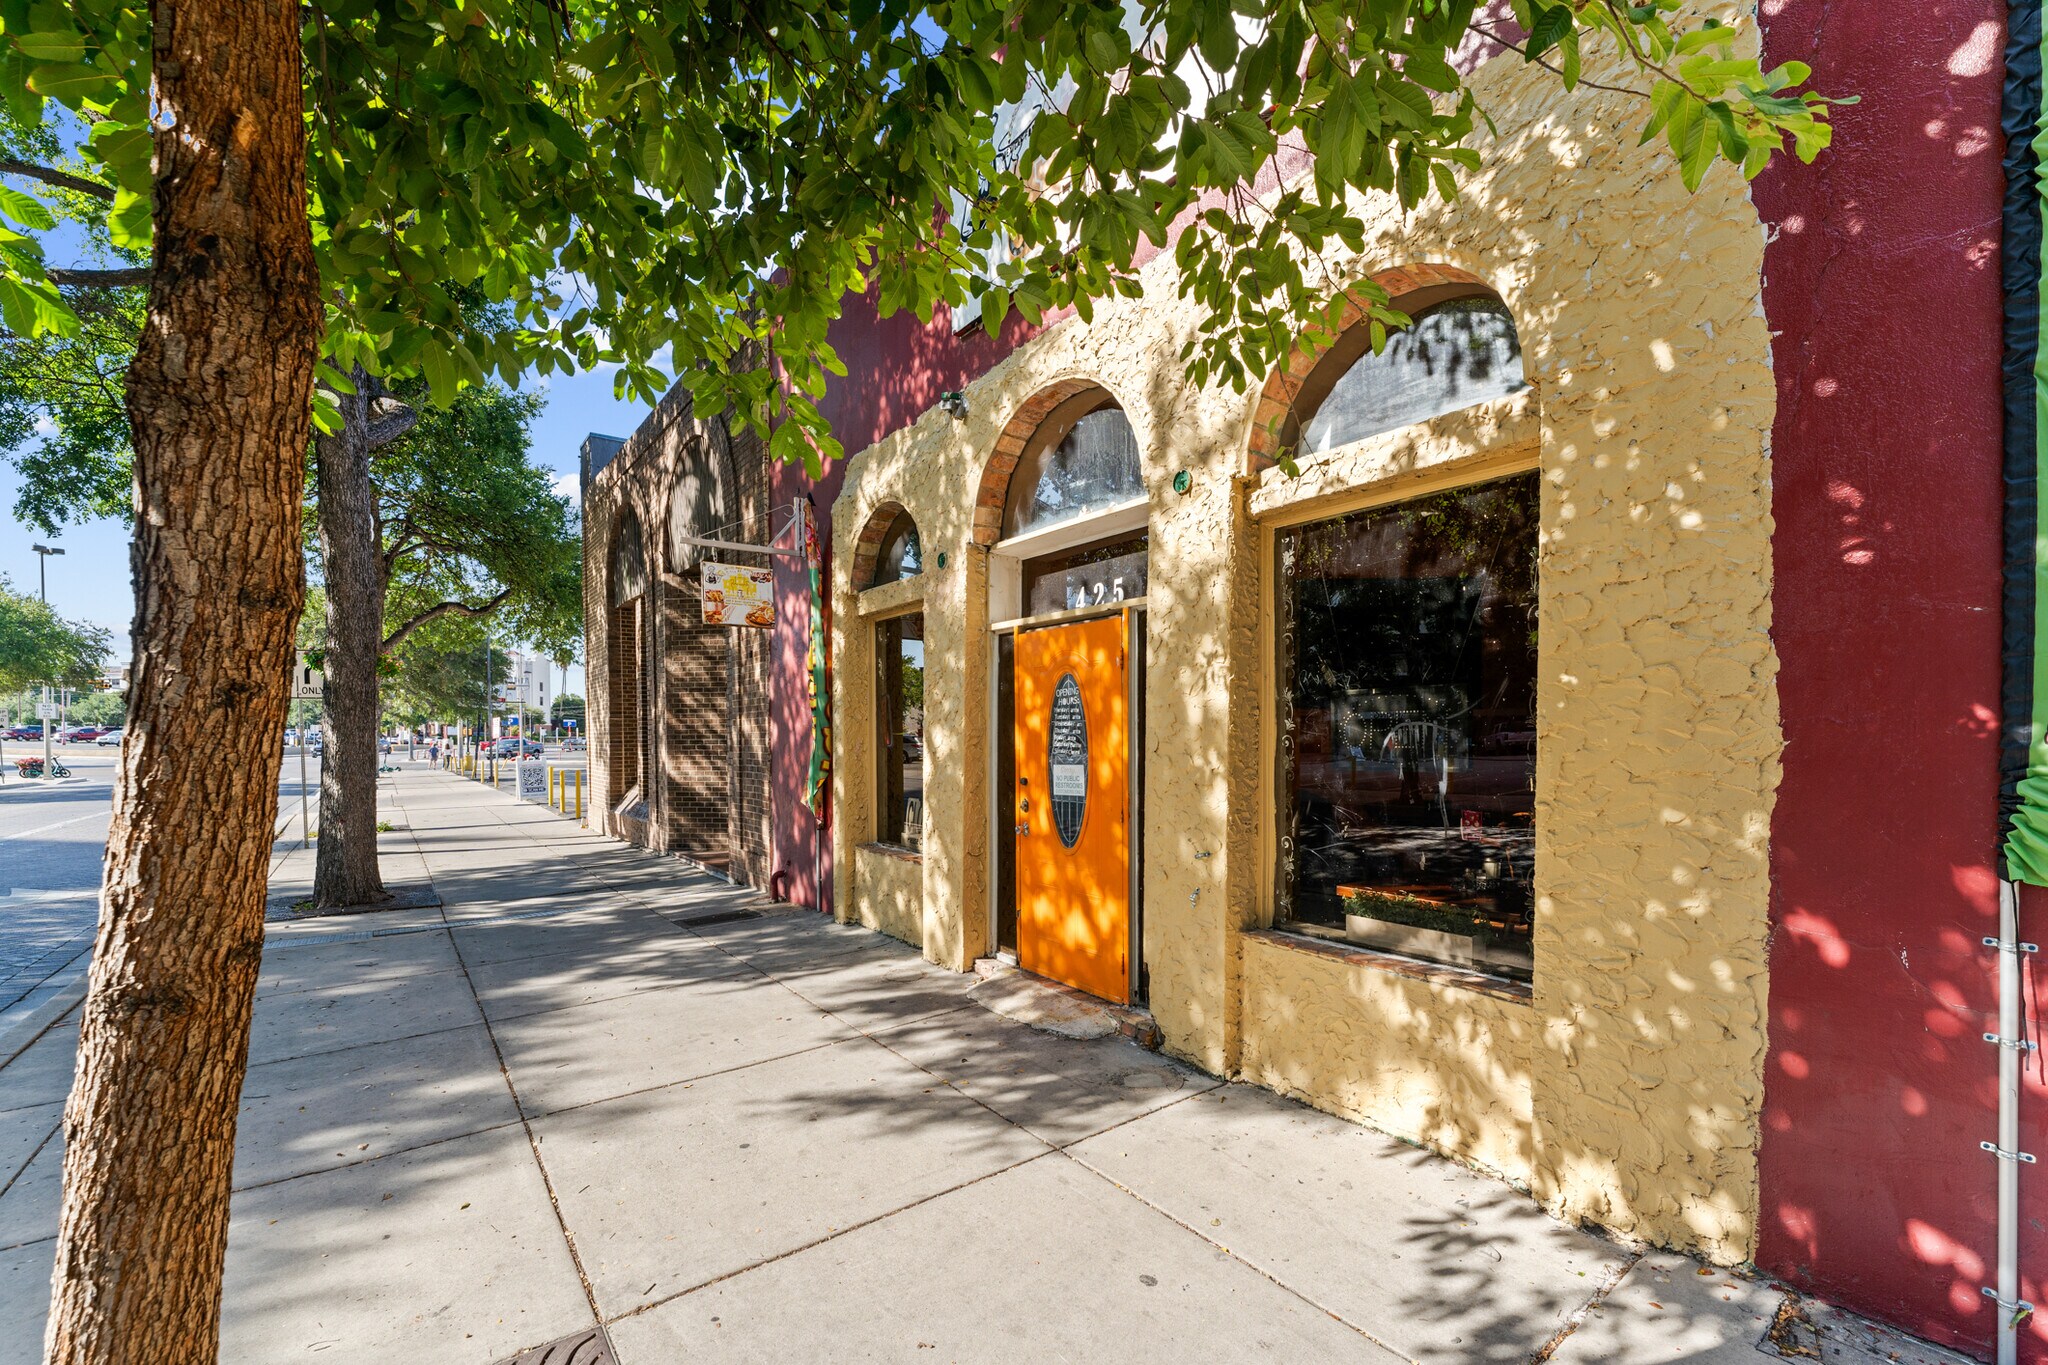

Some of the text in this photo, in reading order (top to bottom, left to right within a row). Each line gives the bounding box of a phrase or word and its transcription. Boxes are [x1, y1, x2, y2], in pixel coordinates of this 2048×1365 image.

[1075, 577, 1125, 608] 425
[1056, 687, 1079, 698] OPENING
[1344, 710, 1448, 749] OPEN
